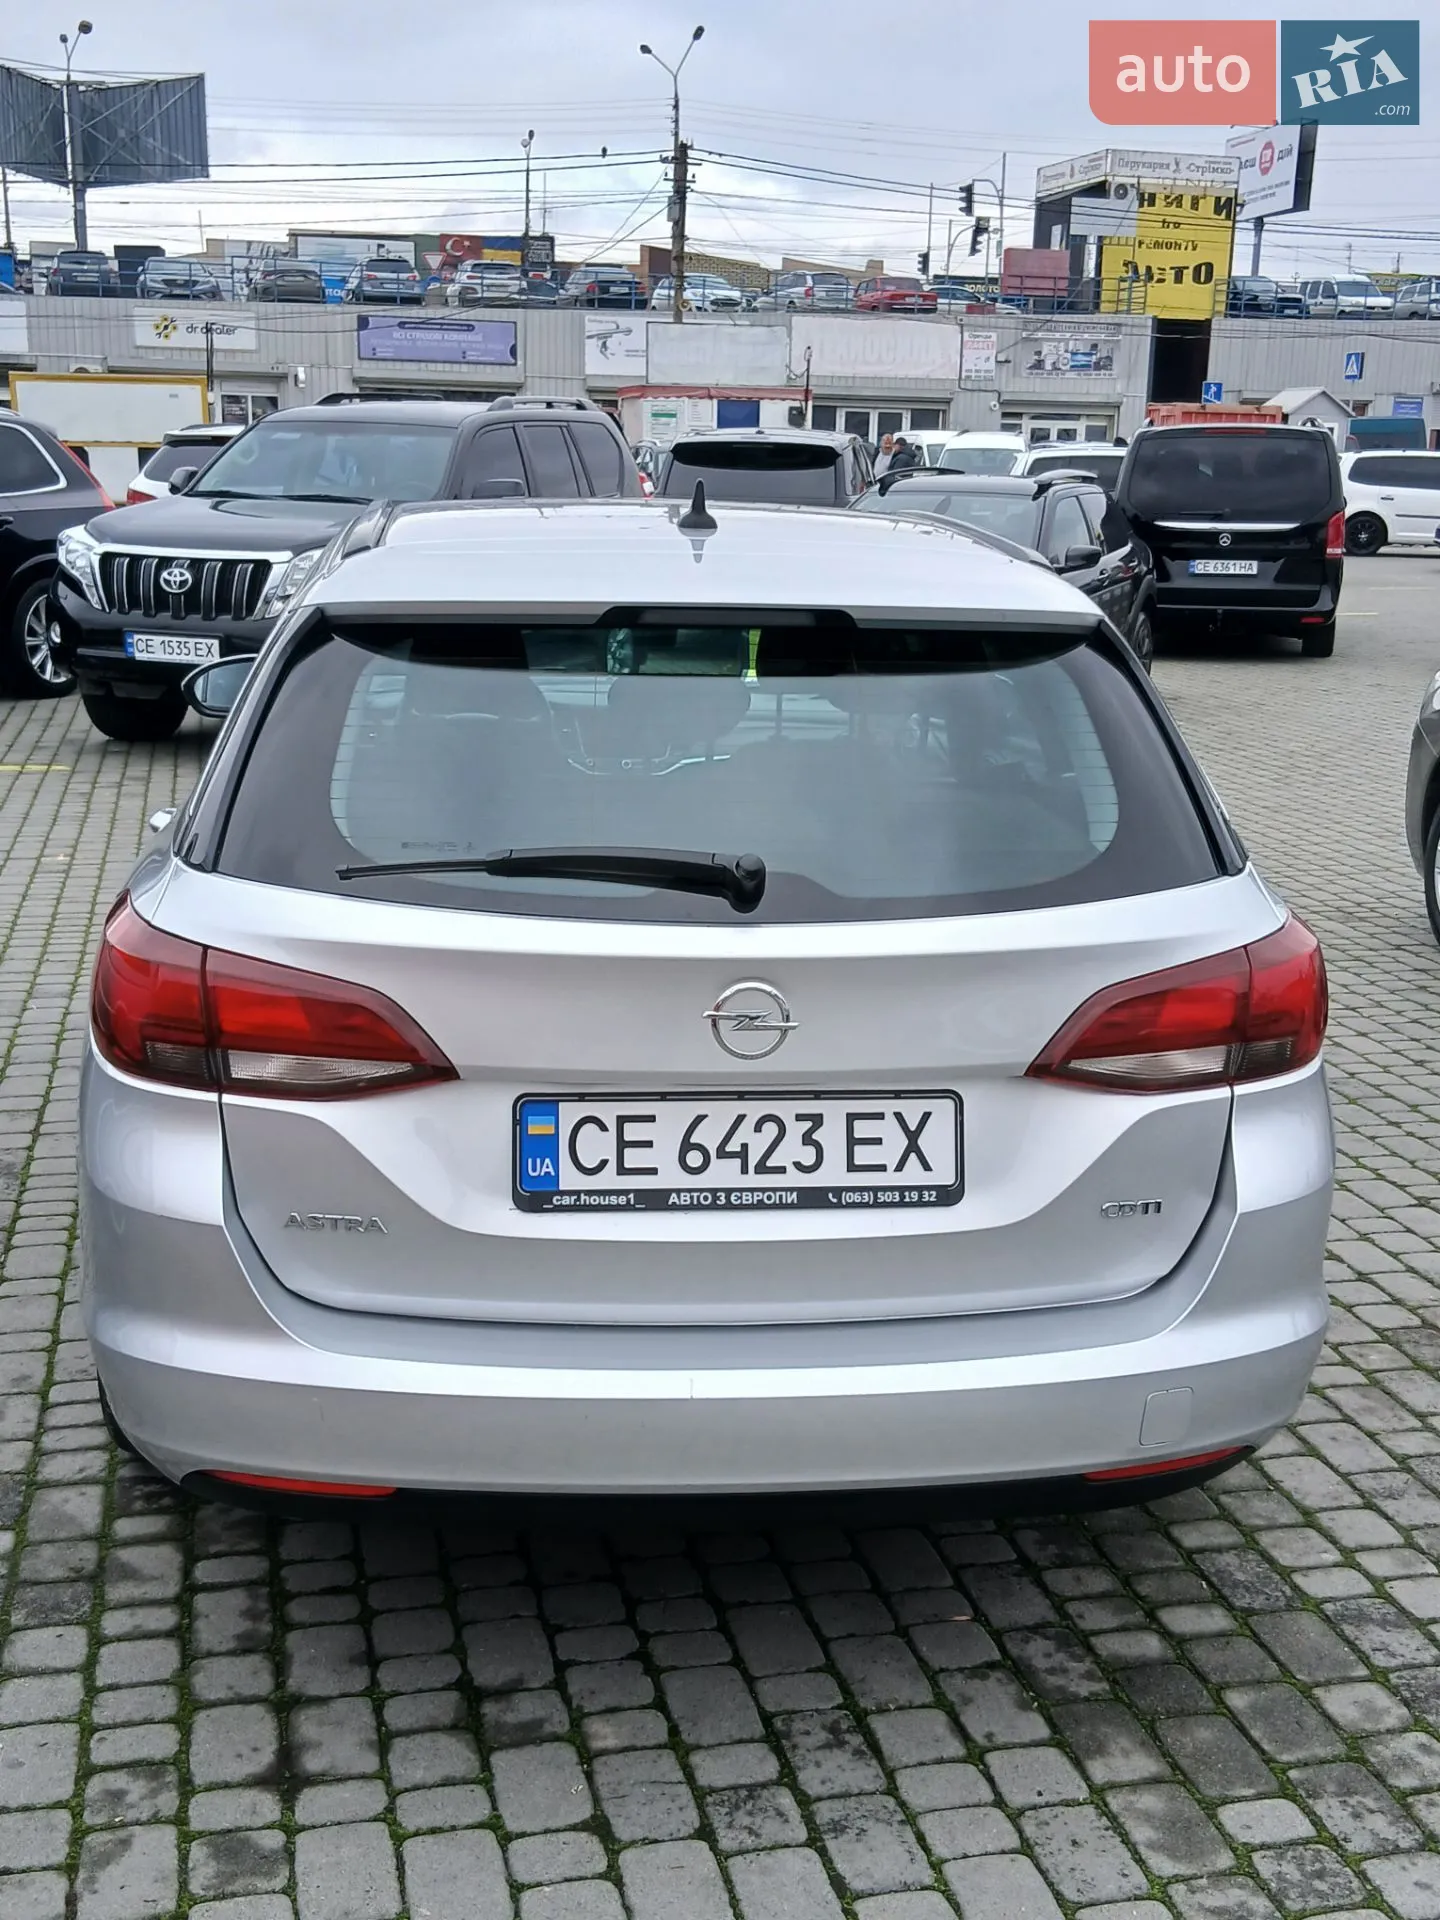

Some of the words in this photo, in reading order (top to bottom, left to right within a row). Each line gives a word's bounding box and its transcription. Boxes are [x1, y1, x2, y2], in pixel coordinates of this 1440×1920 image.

[1137, 239, 1199, 251] РЕМОНТУ
[1196, 562, 1210, 572] CE
[1213, 562, 1237, 572] 6361
[1239, 562, 1254, 572] HA
[135, 638, 155, 654] CE
[160, 639, 191, 656] 1535
[194, 642, 215, 658] EX
[568, 1115, 658, 1176] CE
[678, 1113, 824, 1176] 6423
[846, 1111, 933, 1173] EX
[527, 1158, 555, 1177] UA
[668, 1193, 712, 1206] АВТО
[730, 1191, 798, 1205] ЄВРОПИ
[841, 1191, 873, 1205] (063)
[877, 1191, 900, 1203] 503
[903, 1190, 918, 1202] 19
[921, 1190, 937, 1202] 32
[1101, 1199, 1162, 1218] CDTI
[284, 1212, 388, 1234] ASTRA
